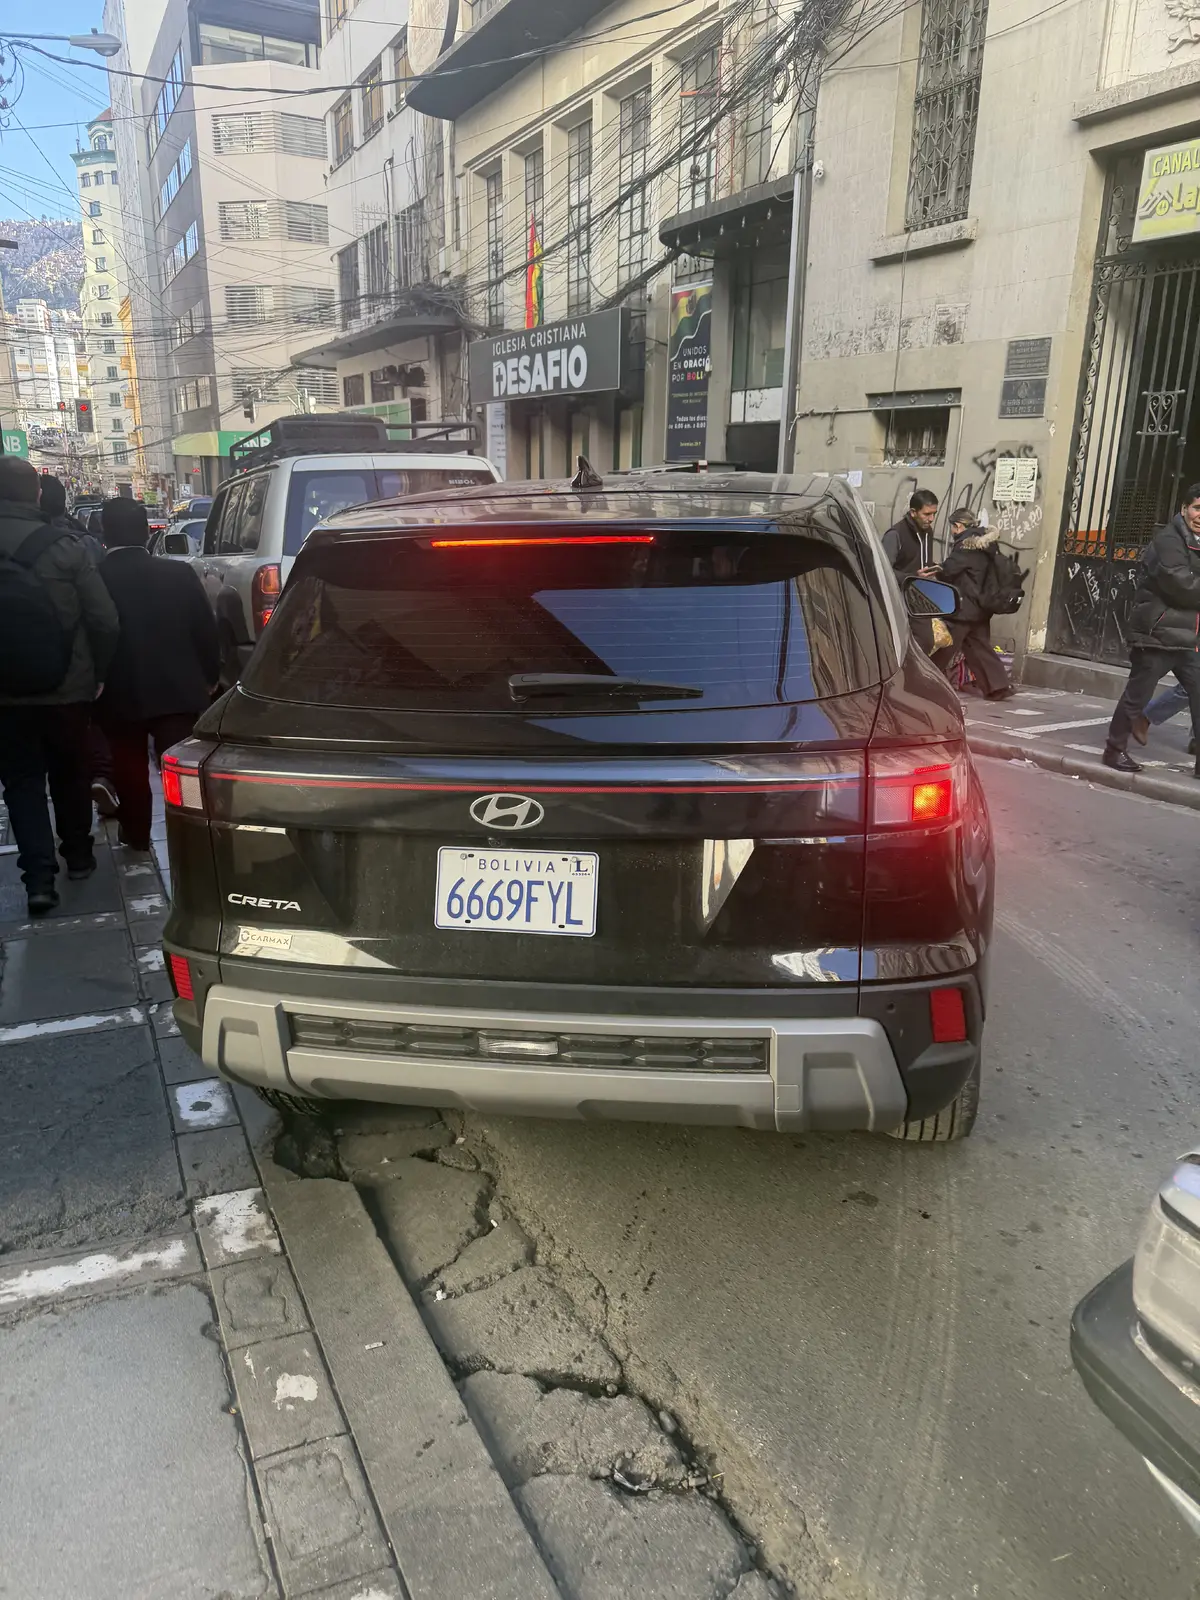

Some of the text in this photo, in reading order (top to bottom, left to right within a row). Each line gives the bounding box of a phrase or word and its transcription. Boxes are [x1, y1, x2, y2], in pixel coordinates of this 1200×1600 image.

[1152, 148, 1200, 177] CANAL
[1172, 182, 1200, 216] La
[492, 322, 587, 356] IGLESIA CRISTIANA
[682, 345, 707, 357] UNIDOS
[492, 344, 588, 397] DESAFIO
[673, 361, 682, 370] EN
[671, 370, 706, 382] POR BOLI
[478, 858, 555, 873] BOLIVIA
[227, 893, 302, 912] CRETA
[446, 876, 584, 926] 6669FYL
[250, 934, 290, 946] CARMAX
